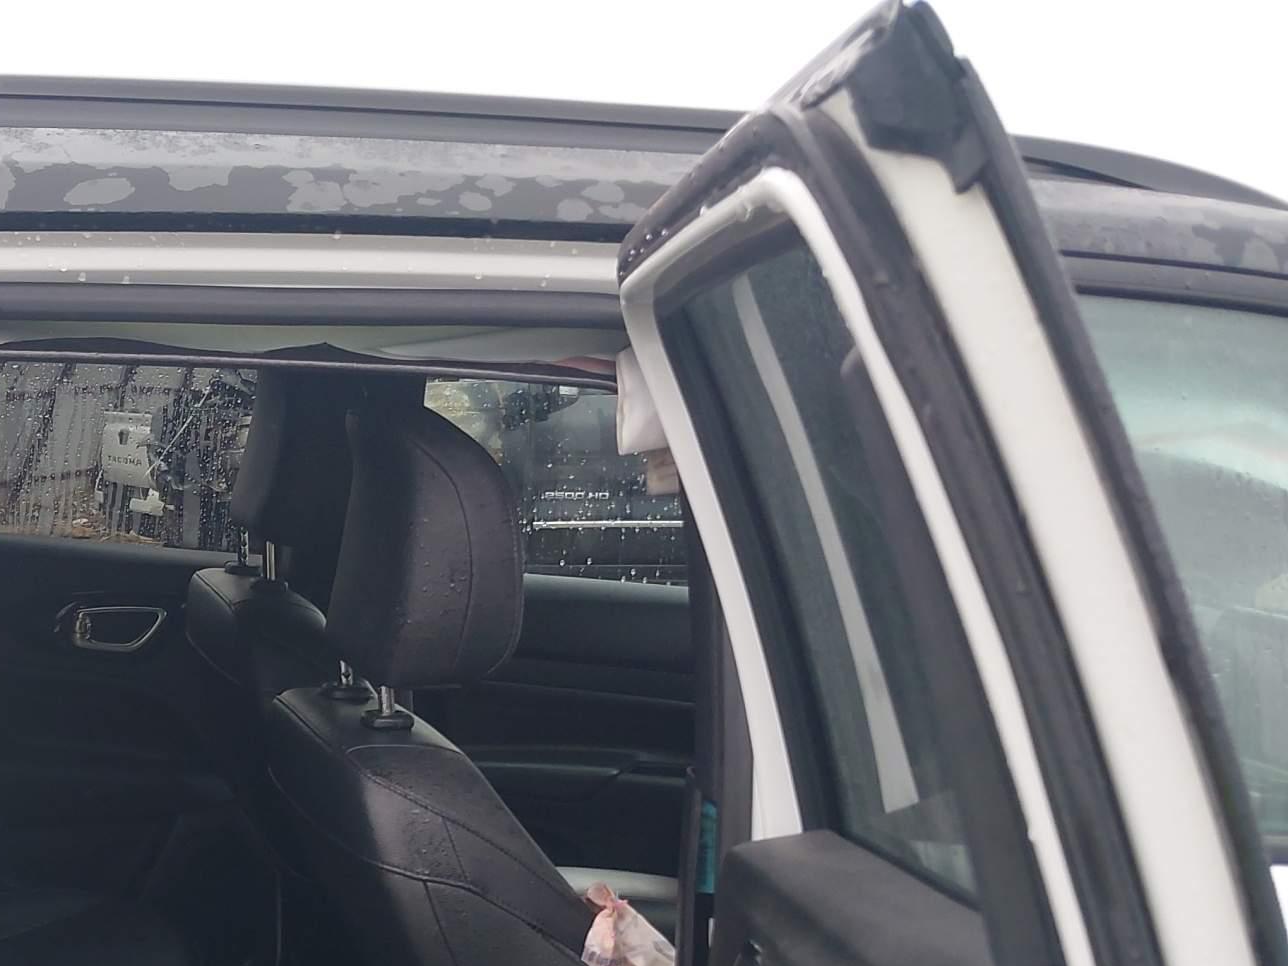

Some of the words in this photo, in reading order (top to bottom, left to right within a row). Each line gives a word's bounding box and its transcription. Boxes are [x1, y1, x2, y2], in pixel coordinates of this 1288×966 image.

[107, 454, 143, 466] TACOMA
[544, 490, 585, 501] 2500
[587, 490, 610, 501] HD
